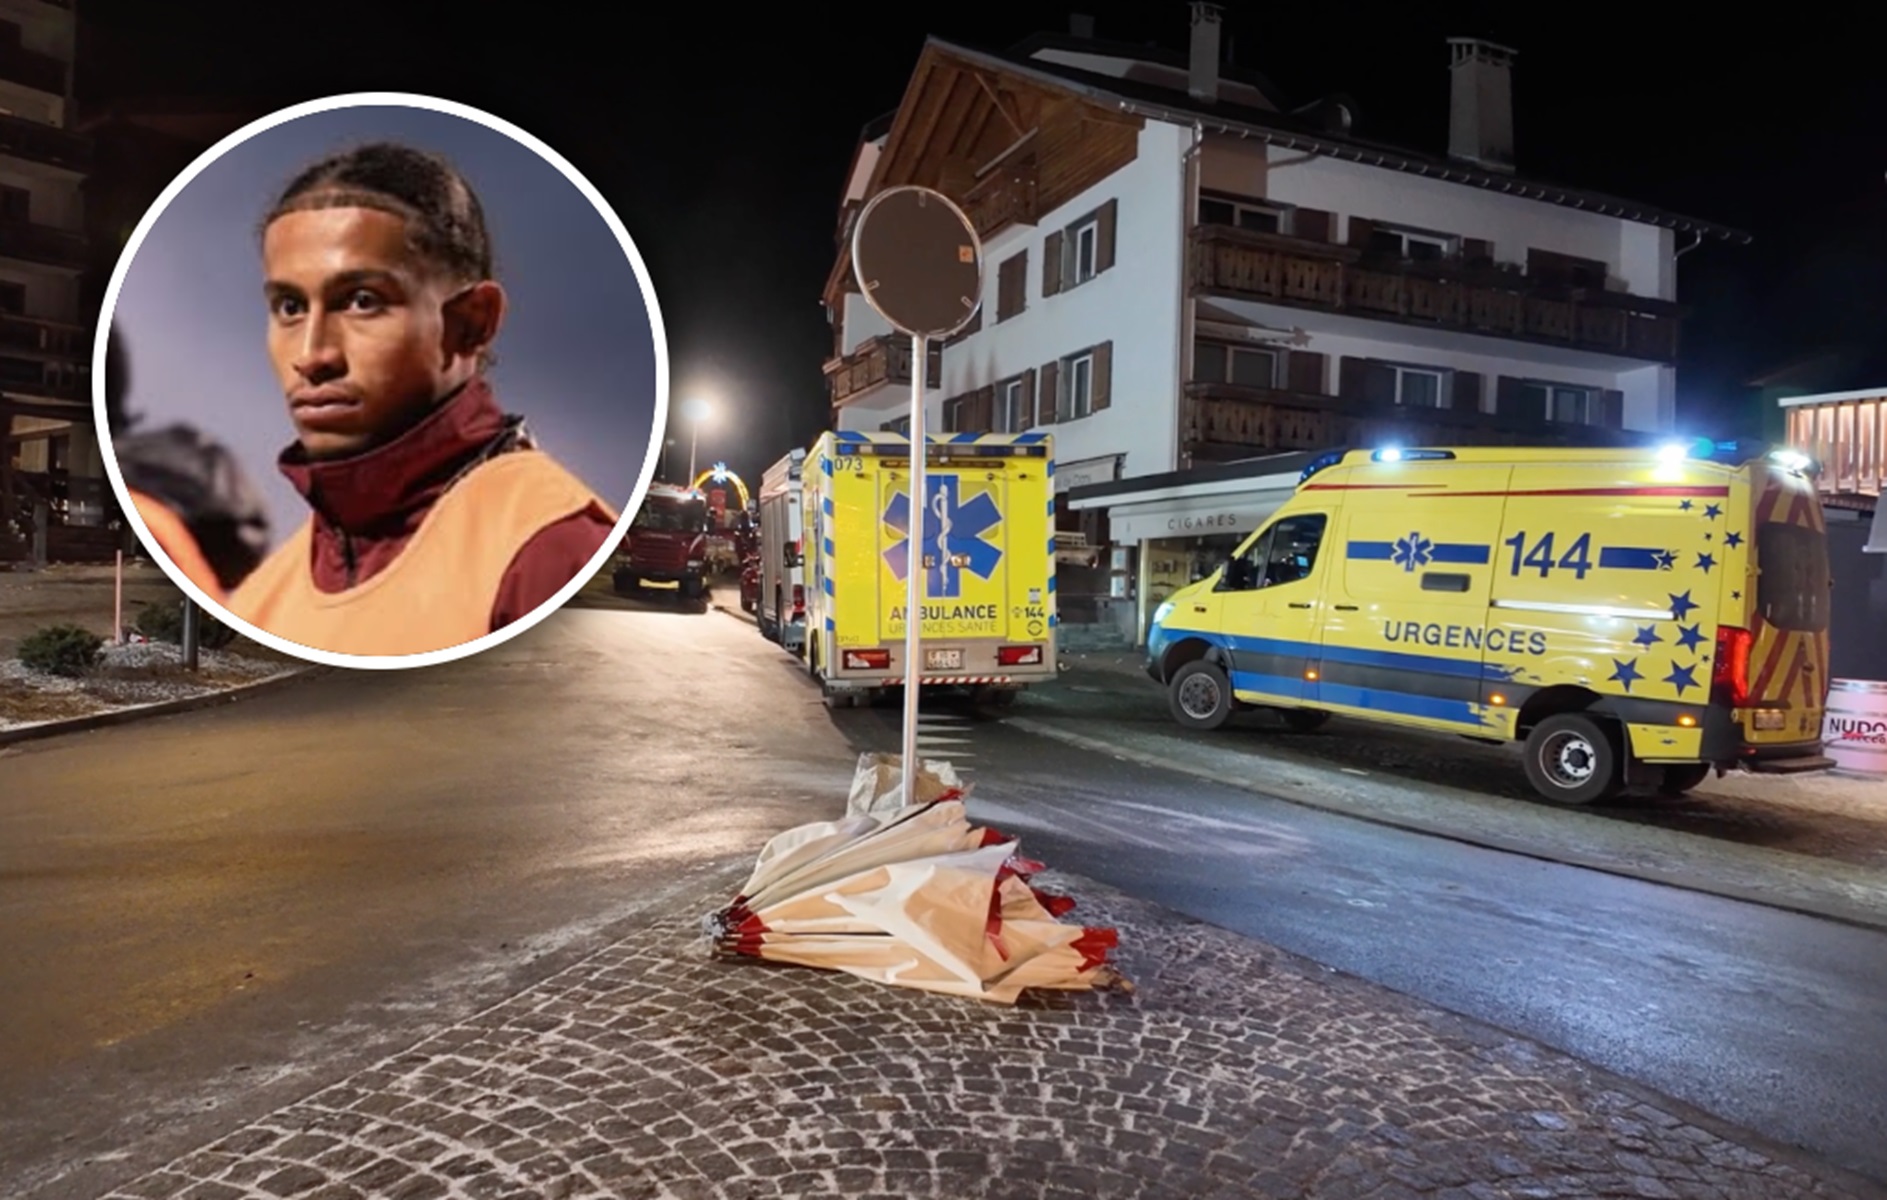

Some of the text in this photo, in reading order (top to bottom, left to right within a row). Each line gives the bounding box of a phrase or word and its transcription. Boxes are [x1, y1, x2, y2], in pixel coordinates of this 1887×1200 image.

[834, 456, 863, 471] 073
[1167, 513, 1237, 530] CIGARES
[1505, 530, 1593, 580] 144
[1024, 606, 1045, 618] 144
[888, 621, 955, 634] URNCES
[1384, 620, 1547, 655] URGENCES
